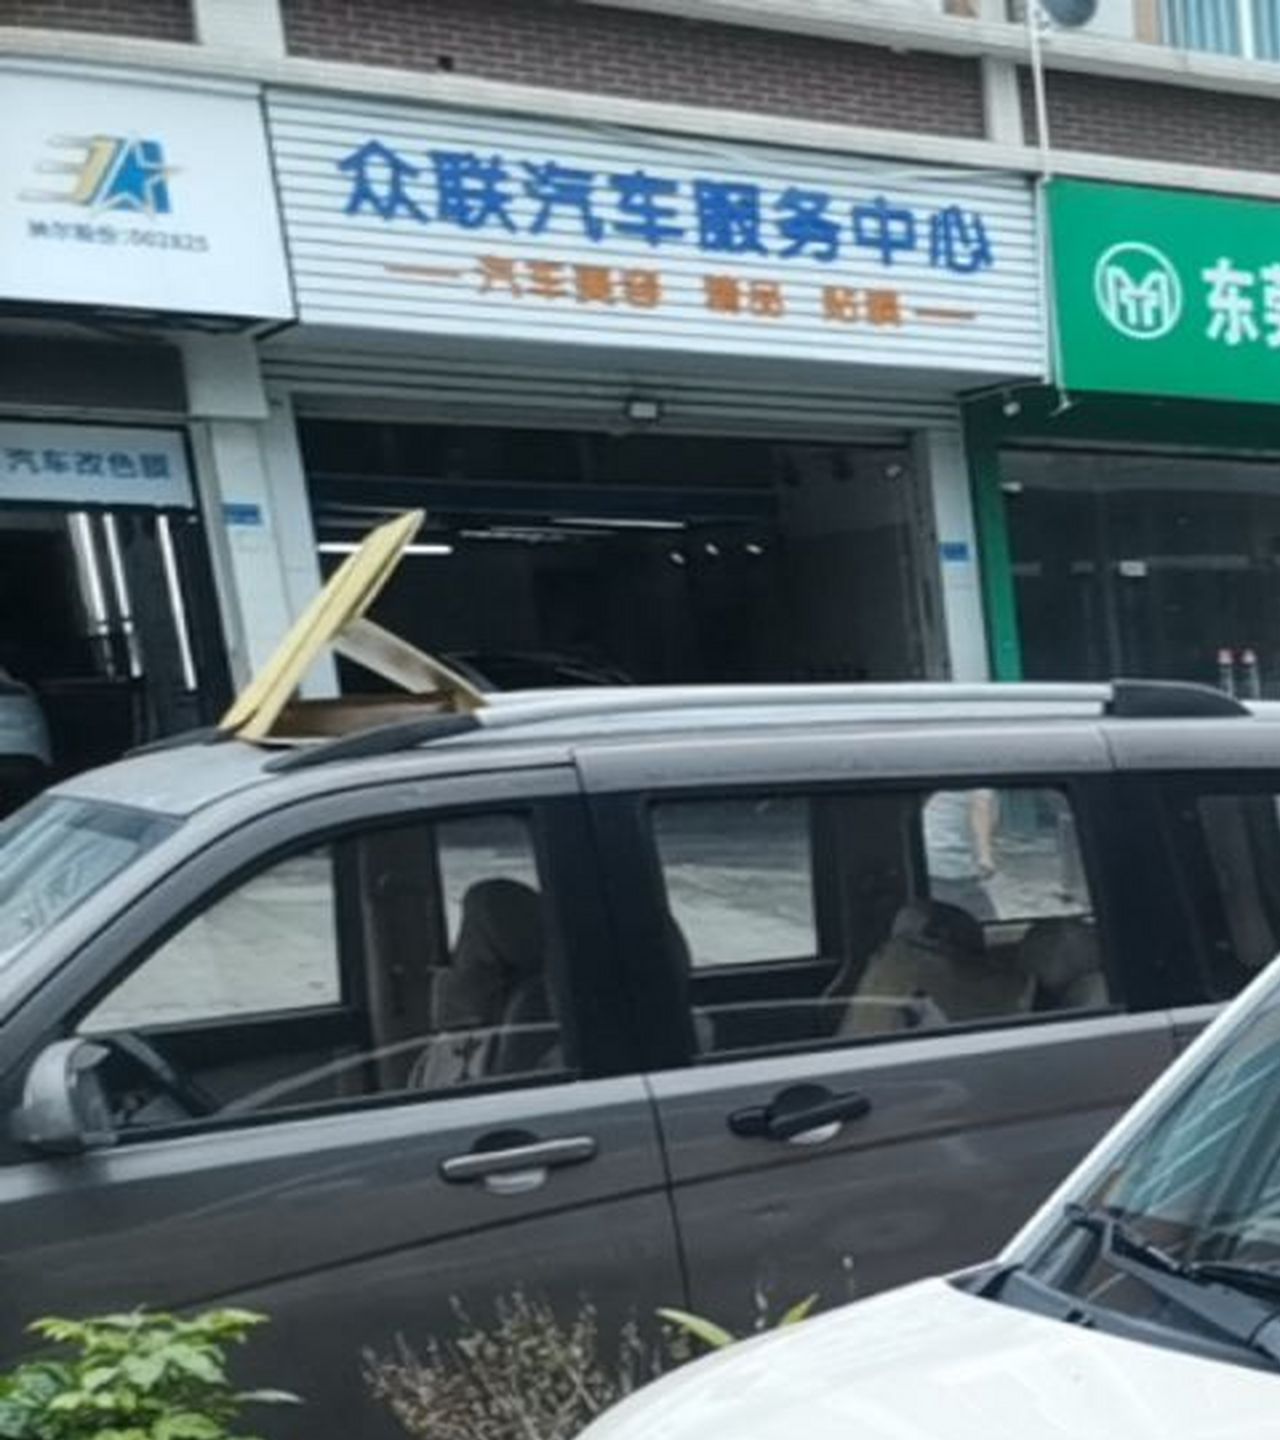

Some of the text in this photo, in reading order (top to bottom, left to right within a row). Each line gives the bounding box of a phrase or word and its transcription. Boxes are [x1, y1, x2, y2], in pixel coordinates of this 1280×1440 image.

[337, 138, 993, 274] 众联汽车服务中心
[475, 255, 662, 310] 汽车美容
